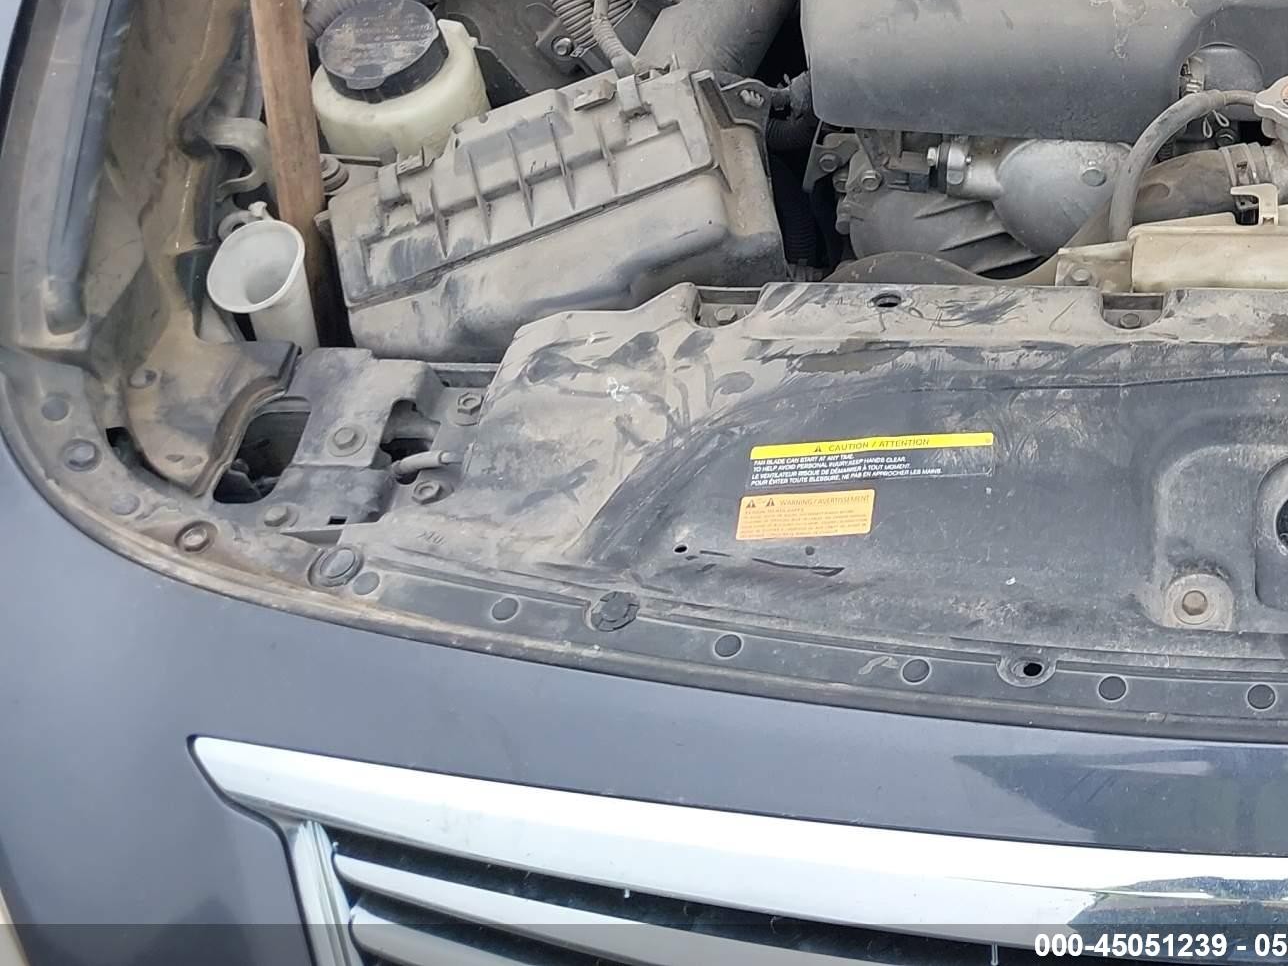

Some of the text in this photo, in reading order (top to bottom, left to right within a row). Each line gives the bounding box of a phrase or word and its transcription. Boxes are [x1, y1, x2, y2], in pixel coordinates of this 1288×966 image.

[828, 441, 869, 453] CAUTION
[879, 438, 929, 448] ATTENTION
[753, 465, 762, 473] TO
[762, 464, 778, 472] HELP
[778, 463, 797, 471] AVOID
[797, 461, 828, 470] PERSONAL
[864, 456, 886, 464] HANDS
[827, 454, 841, 462] ANY
[751, 479, 768, 487] POUR
[789, 475, 809, 484] TOUTE
[842, 472, 851, 481] NE
[851, 471, 863, 479] PAS
[863, 470, 872, 478] EN
[760, 470, 798, 479] VENTILATEUR
[798, 468, 821, 477] RISQUE
[821, 468, 830, 476] DE
[780, 497, 813, 506] WARNING
[819, 494, 870, 506] AVERTISSEMENT
